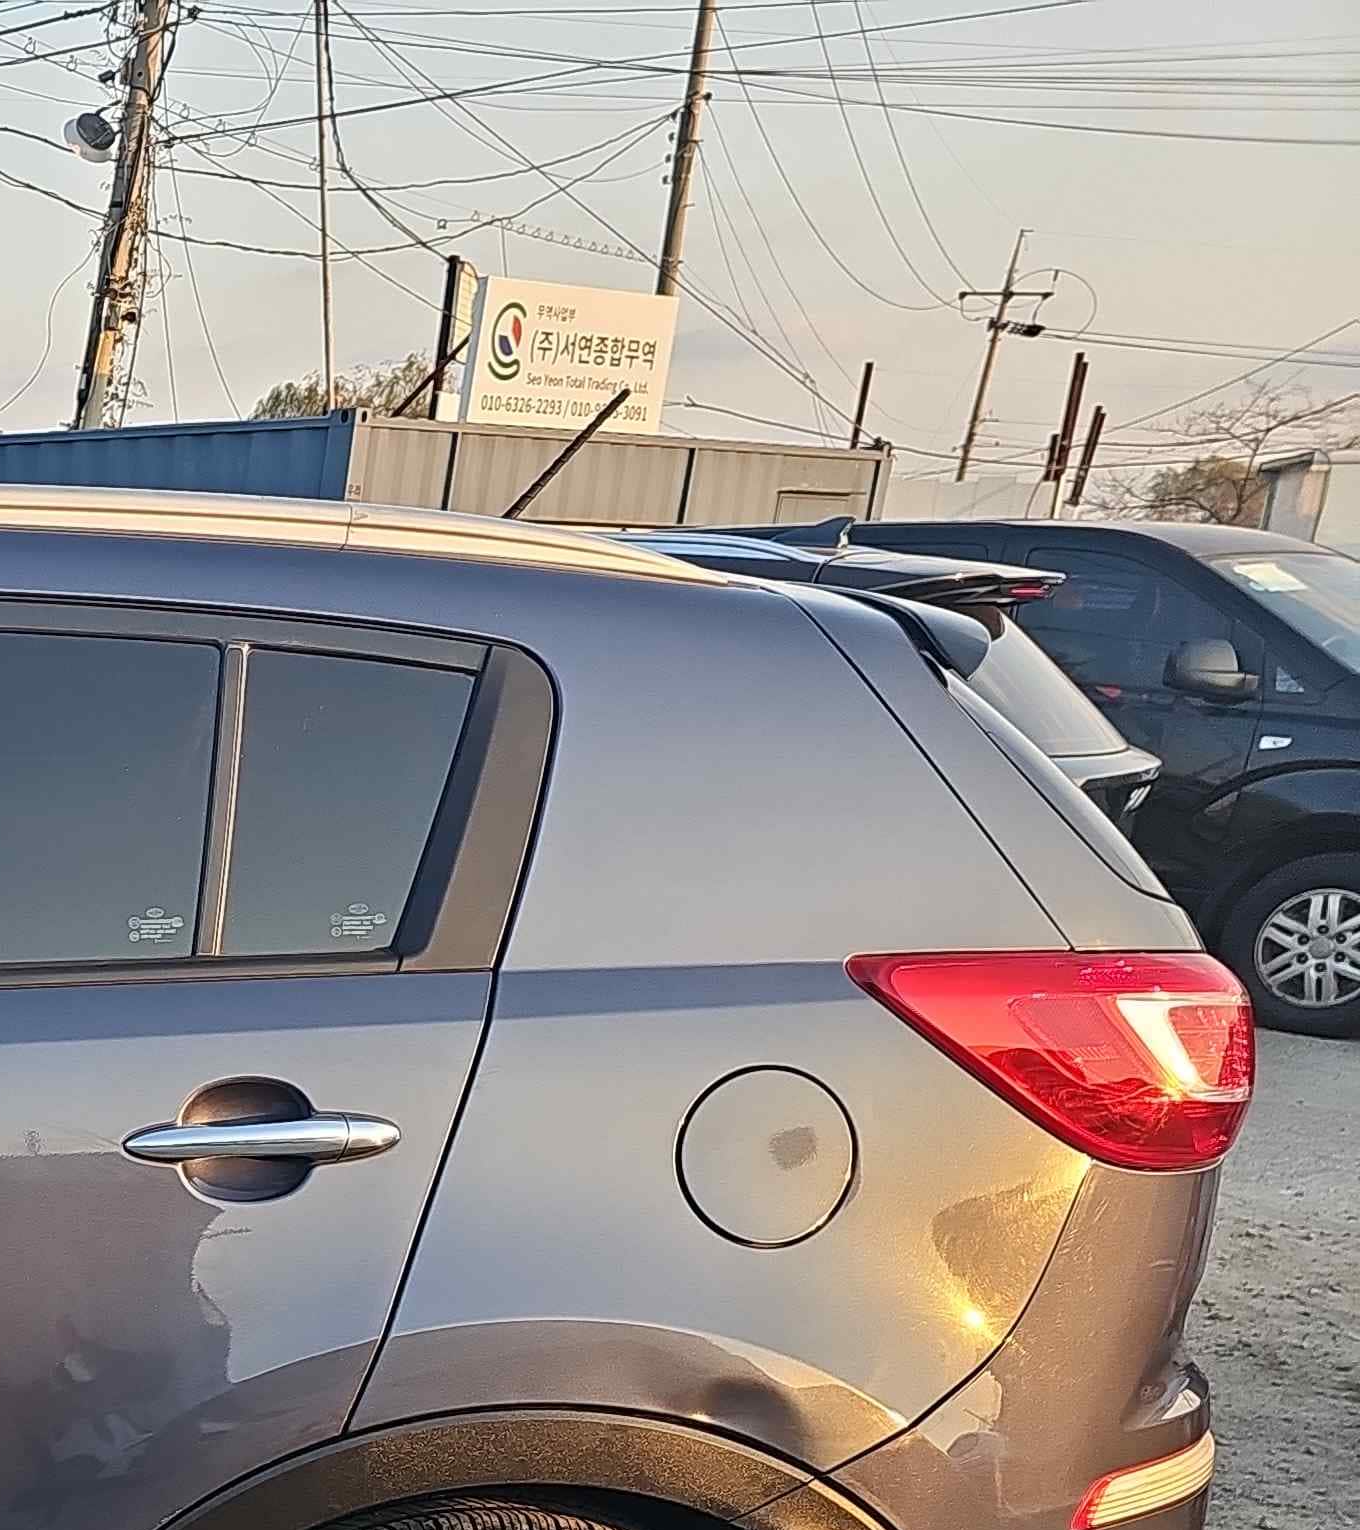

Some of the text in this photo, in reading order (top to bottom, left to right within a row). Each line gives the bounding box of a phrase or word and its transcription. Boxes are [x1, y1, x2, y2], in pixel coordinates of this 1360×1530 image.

[537, 305, 576, 322] 무역사업부
[530, 330, 657, 371] (주)서연종합무역
[566, 375, 585, 389] Total
[588, 376, 618, 395] Trading
